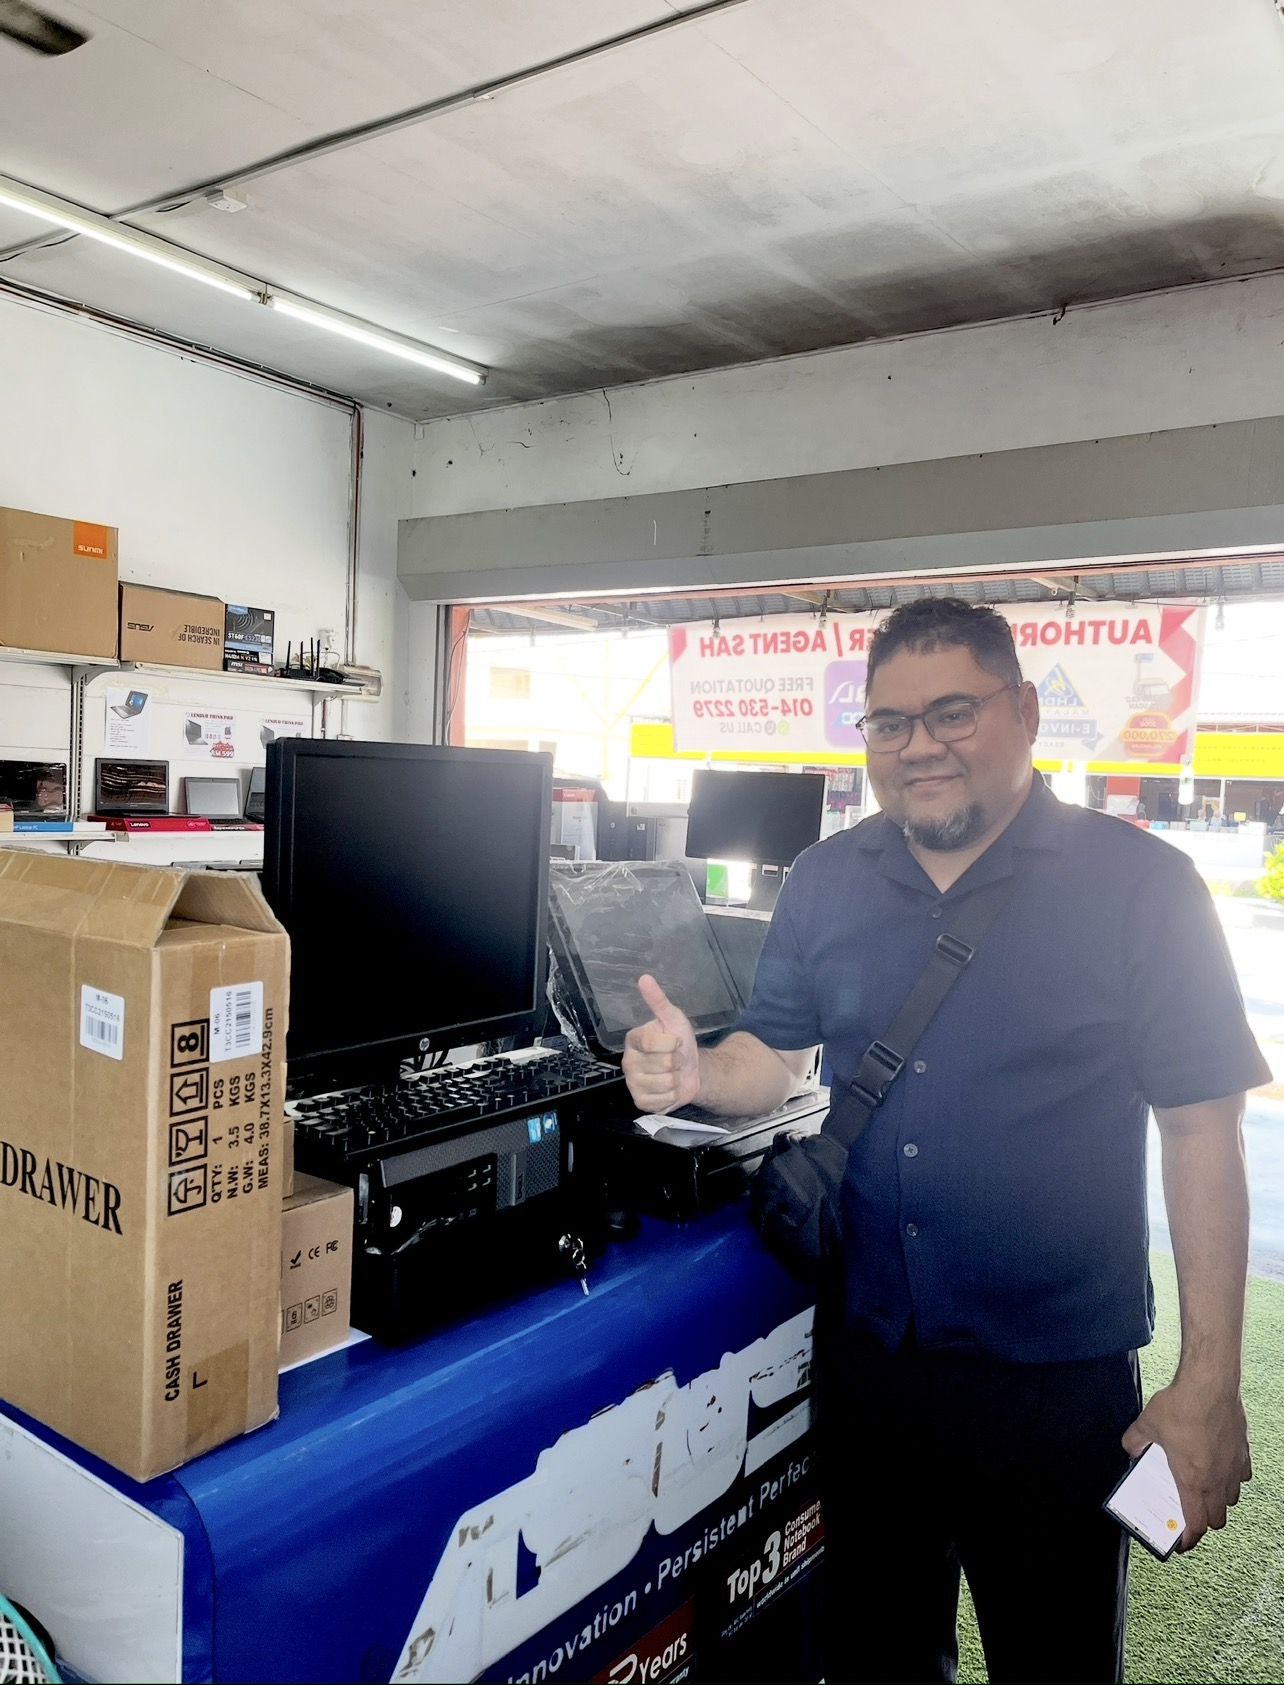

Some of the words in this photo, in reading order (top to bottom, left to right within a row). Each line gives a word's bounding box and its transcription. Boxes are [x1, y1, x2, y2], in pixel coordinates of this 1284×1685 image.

[178, 633, 187, 642] OF
[183, 624, 220, 637] INCREDIBLE
[188, 634, 212, 645] SEARCH
[213, 1013, 221, 1035] M-06
[224, 991, 233, 1052] T3CC2150516
[244, 1072, 256, 1103] KGS
[259, 1007, 273, 1140] 38.7X13.3X42.9cm
[213, 1078, 224, 1110] PCS
[229, 1075, 241, 1107] KGS
[212, 1136, 223, 1145] 1
[228, 1126, 240, 1149] 3.5
[243, 1122, 255, 1144] 4.0
[227, 1165, 239, 1199] N.W:
[242, 1160, 254, 1194] G.W:
[258, 1143, 270, 1189] MEAS:
[0, 1141, 123, 1236] DRAWER
[308, 1246, 321, 1260] CE
[166, 1279, 183, 1353] DRAWER
[164, 1354, 181, 1402] CASH
[783, 1513, 821, 1552] Notebook
[784, 1500, 822, 1536] Consume
[727, 1559, 762, 1604] Top
[762, 1530, 781, 1584] 3
[782, 1536, 807, 1567] Brand
[508, 1590, 637, 1684] nnovation
[657, 1494, 754, 1591] Persistent
[759, 1455, 812, 1510] Perfec
